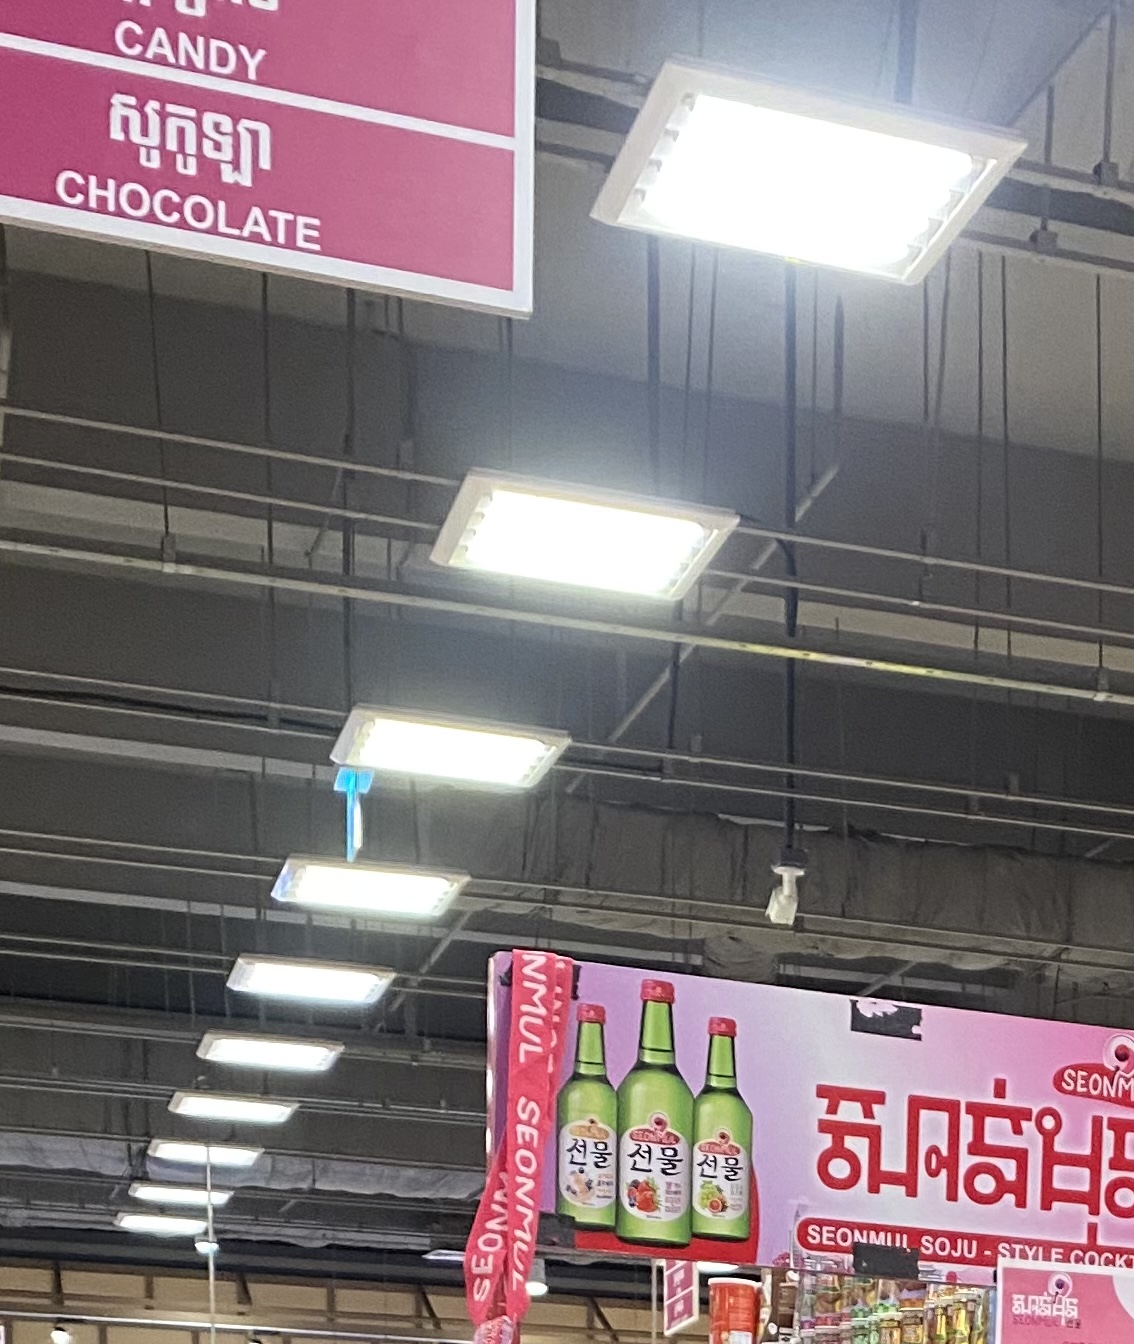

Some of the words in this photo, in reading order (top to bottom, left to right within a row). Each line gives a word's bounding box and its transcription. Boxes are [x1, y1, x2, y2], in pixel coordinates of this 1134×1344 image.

[115, 20, 267, 80] CANDY
[55, 170, 321, 251] CHOCOLATE
[511, 1096, 541, 1291] SEONMUL
[920, 1235, 977, 1259] SOJU
[998, 1243, 1063, 1262] STYLE
